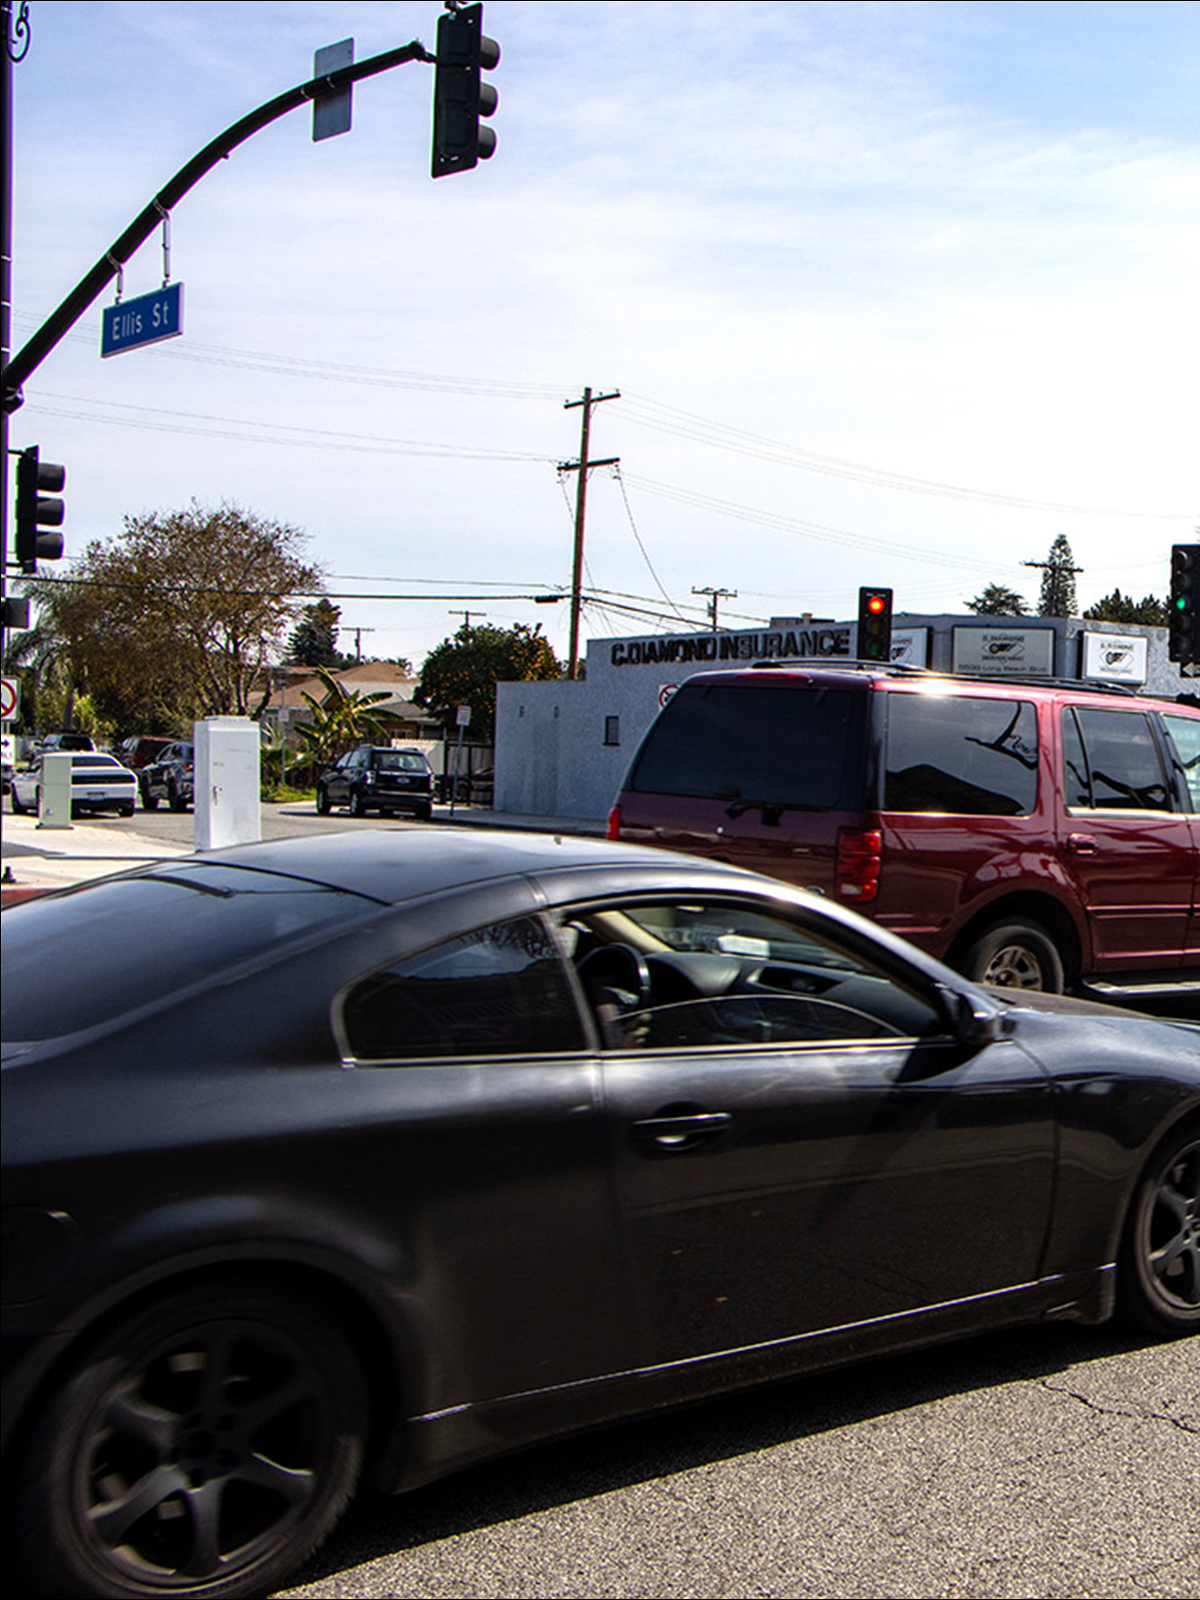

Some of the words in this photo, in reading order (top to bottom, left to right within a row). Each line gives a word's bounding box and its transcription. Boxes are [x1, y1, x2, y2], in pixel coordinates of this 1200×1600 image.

[112, 311, 142, 341] Ellis
[152, 301, 169, 328] St
[718, 629, 850, 660] INSURANCE
